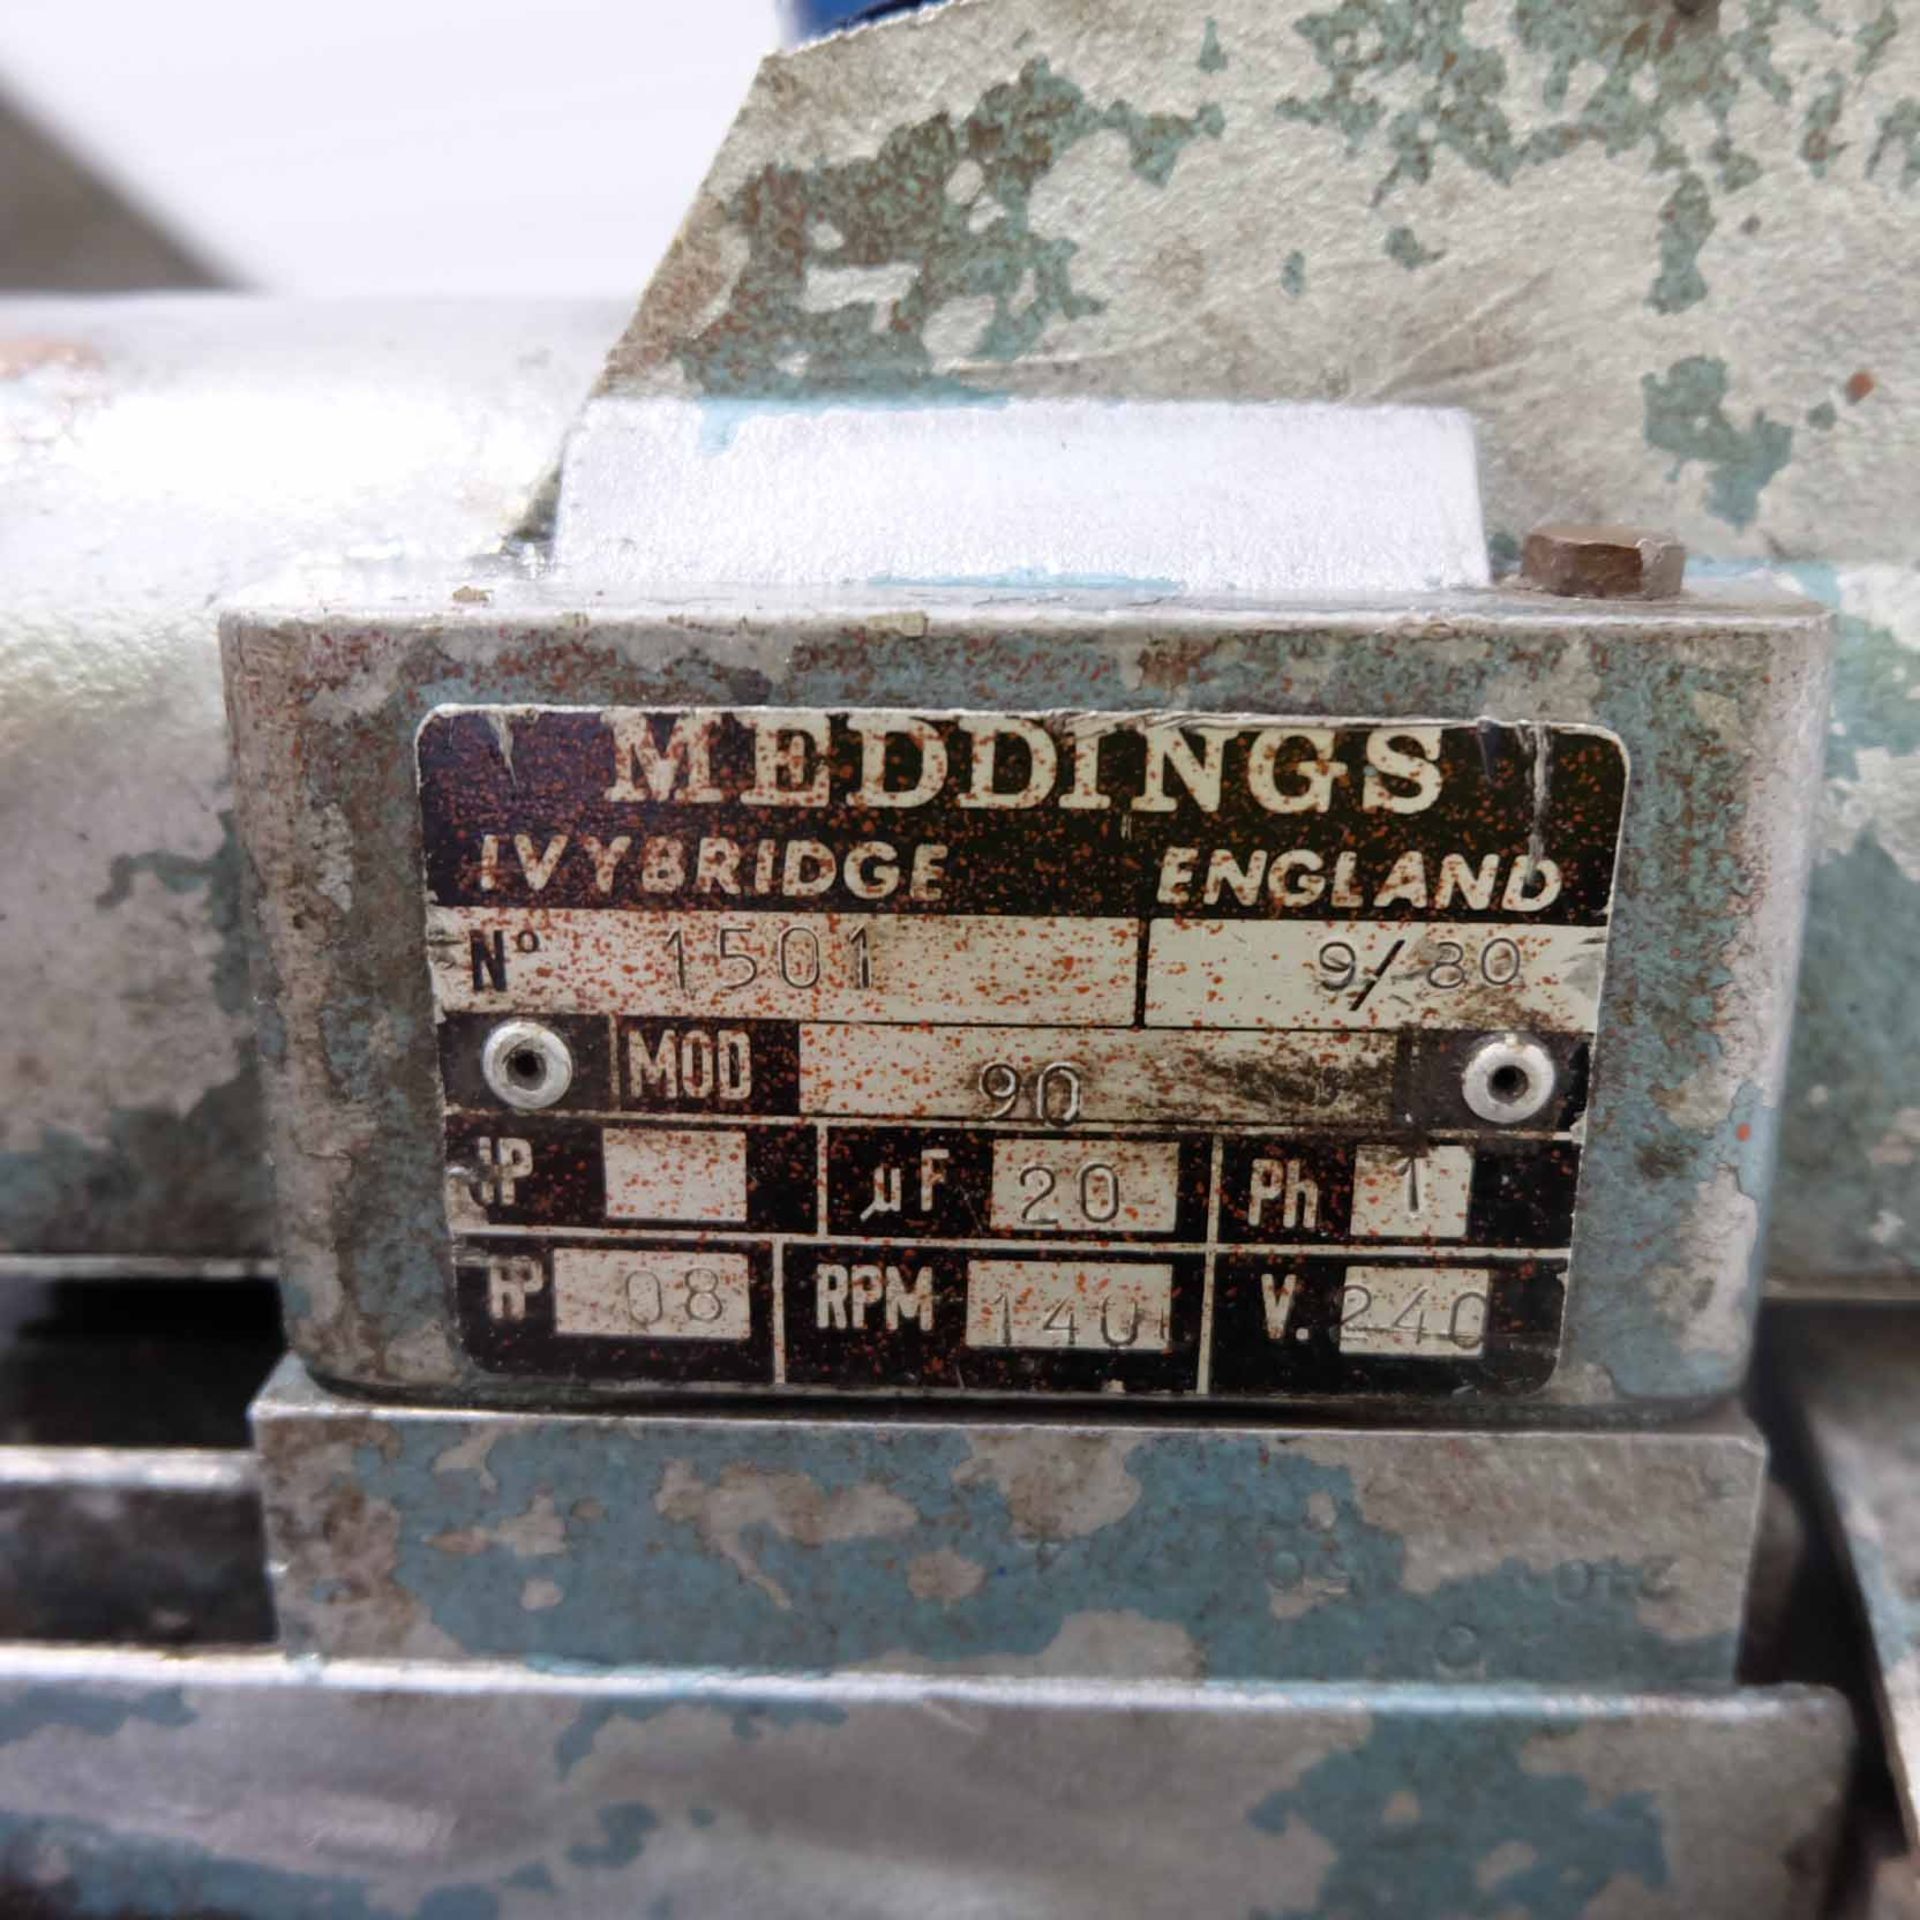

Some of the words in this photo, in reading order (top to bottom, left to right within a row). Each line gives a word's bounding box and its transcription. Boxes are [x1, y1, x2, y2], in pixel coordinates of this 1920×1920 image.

[604, 712, 1443, 815] MEDDINGS
[478, 834, 949, 900] IVYBRIDGE
[1156, 846, 1562, 914] ENGLAND
[664, 925, 871, 989] 1501
[627, 1028, 751, 1100] MOD
[979, 1062, 1081, 1127] 90
[1018, 1162, 1120, 1226] 20
[1247, 1157, 1319, 1229] Ph
[1397, 1156, 1420, 1214] 1
[815, 1263, 934, 1332] RPM
[1334, 1284, 1489, 1350] 240
